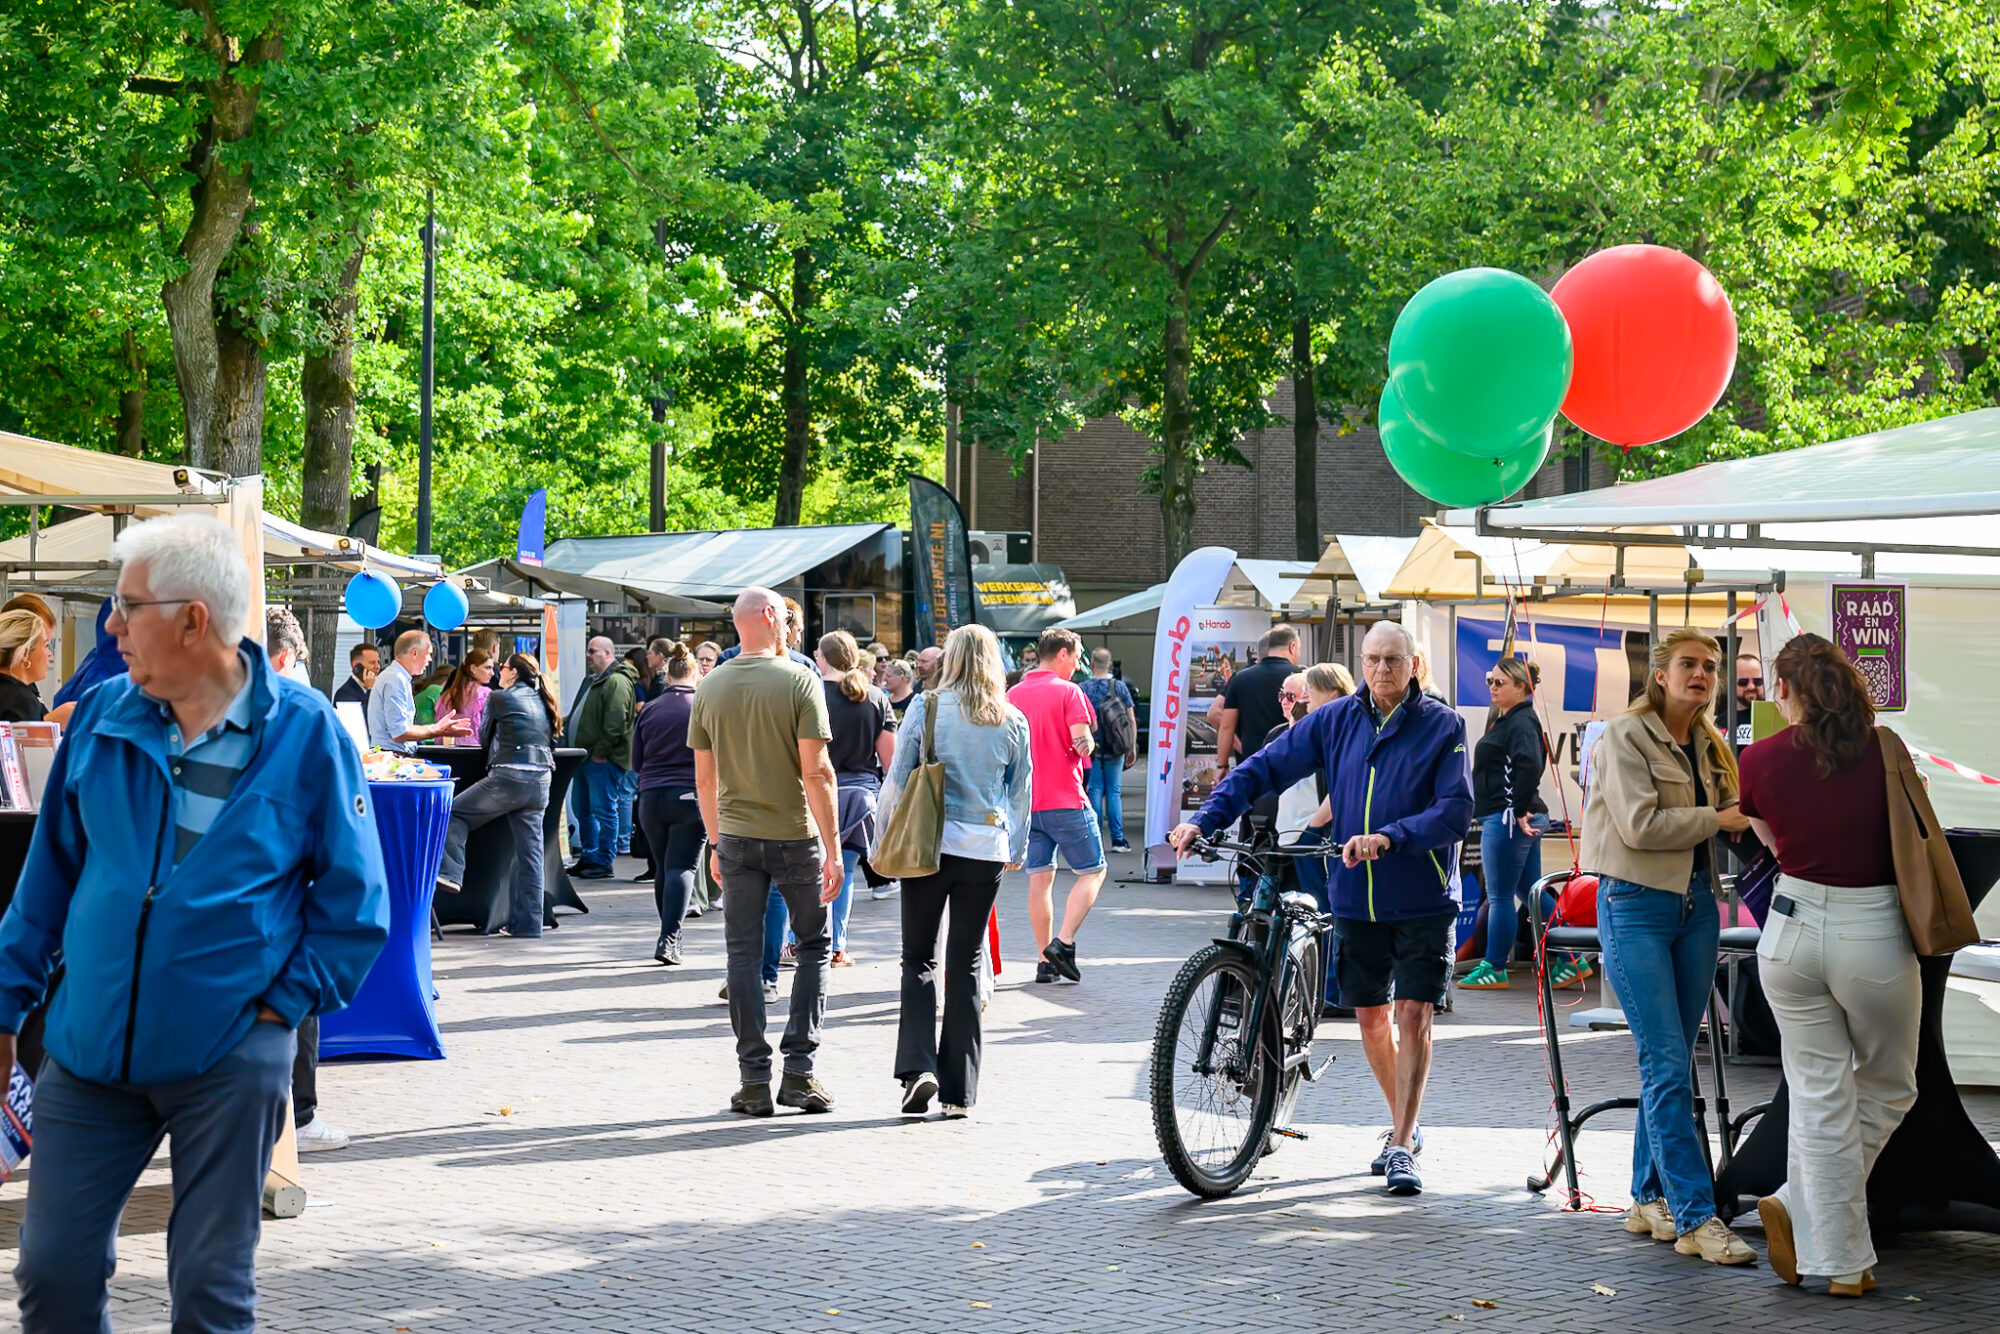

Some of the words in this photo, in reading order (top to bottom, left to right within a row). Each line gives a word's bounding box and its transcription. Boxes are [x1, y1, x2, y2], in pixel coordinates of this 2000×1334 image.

[930, 519, 947, 619] DEFENSIE.NL
[1846, 600, 1894, 617] RAAD
[1205, 619, 1231, 629] Hanab
[1864, 617, 1879, 628] EN
[1851, 628, 1890, 645] WIN
[1158, 615, 1191, 749] Hanab
